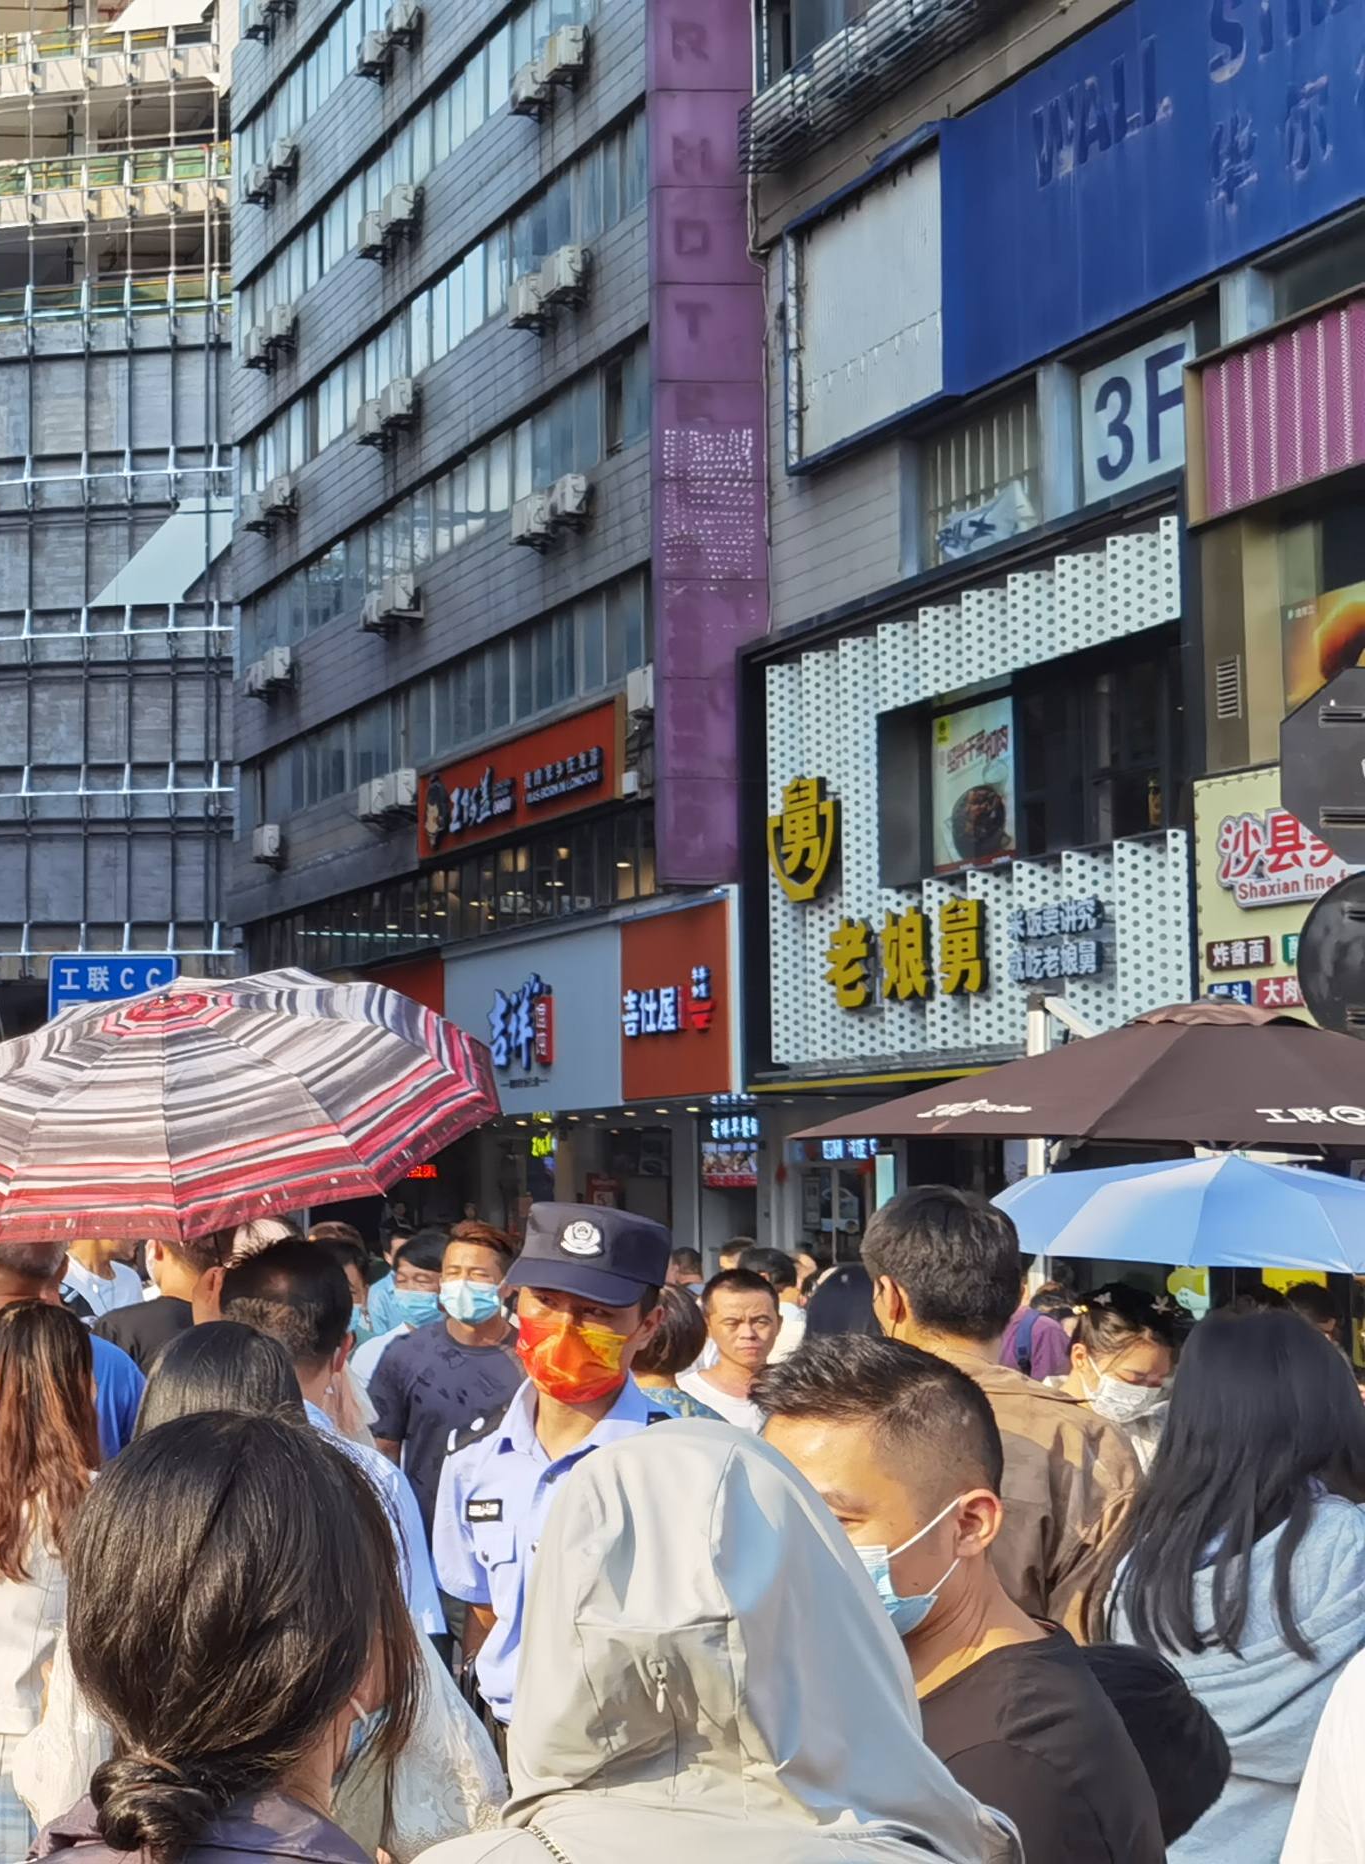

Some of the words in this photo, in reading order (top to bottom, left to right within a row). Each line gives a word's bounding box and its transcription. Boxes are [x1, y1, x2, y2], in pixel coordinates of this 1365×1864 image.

[1095, 343, 1185, 482] 3F
[1238, 880, 1300, 899] Shaxian
[1304, 873, 1336, 892] fine
[826, 894, 982, 1008] 老娘舅
[1212, 939, 1266, 967] 炸酱面
